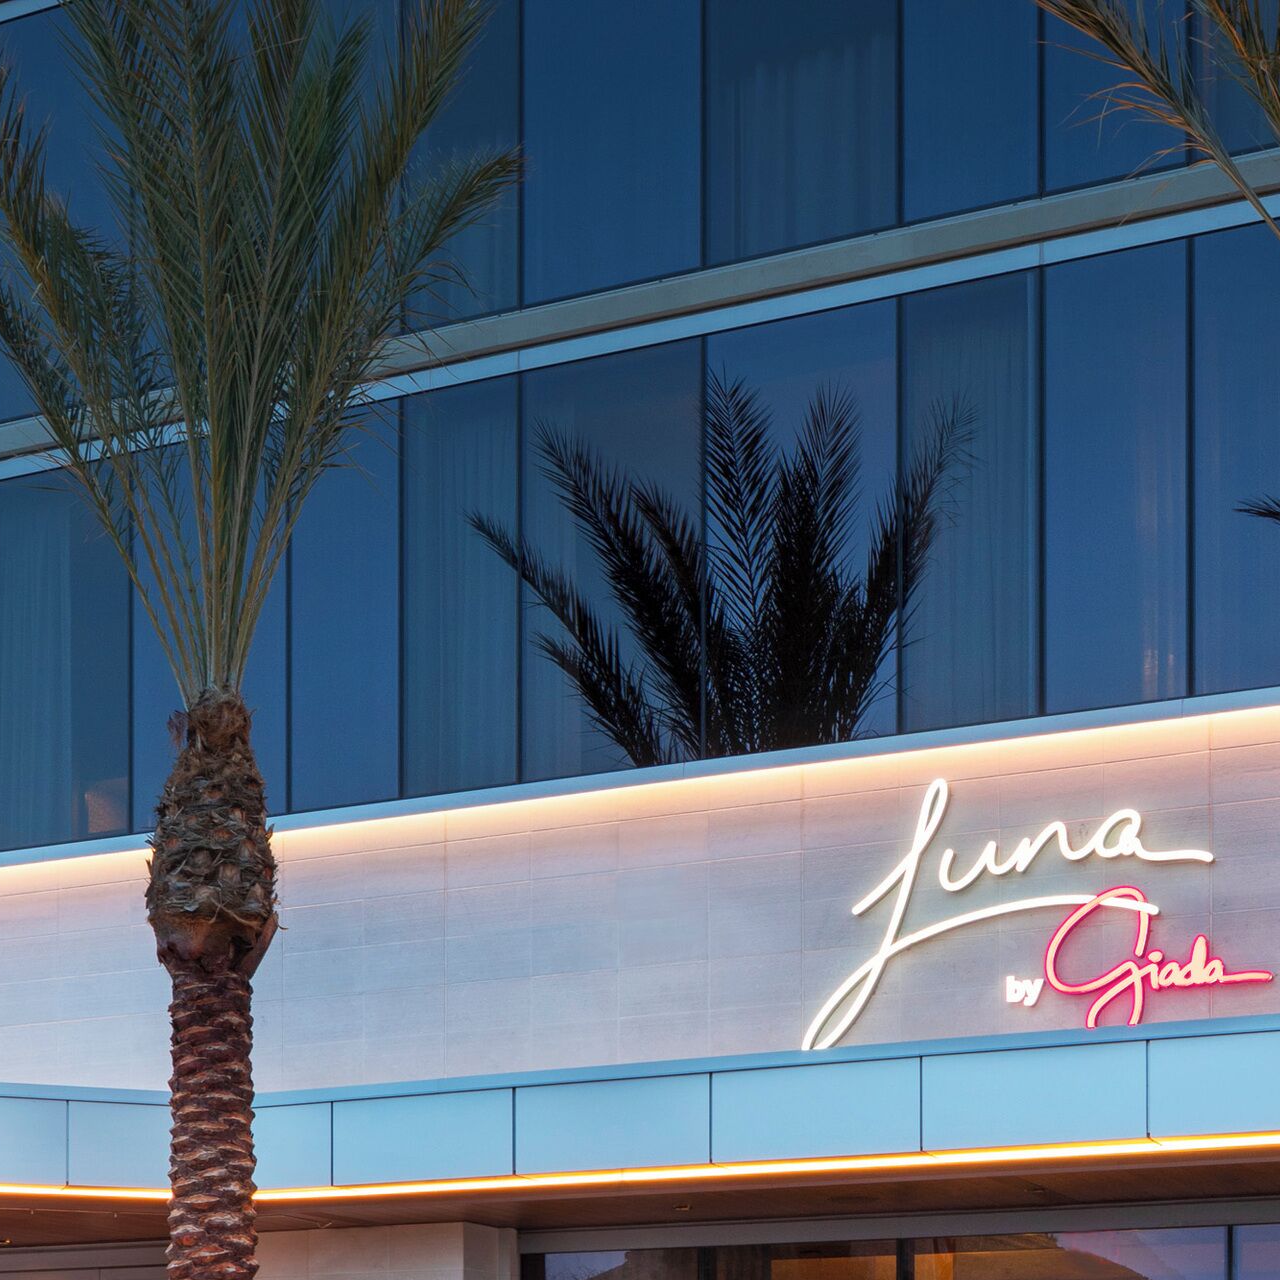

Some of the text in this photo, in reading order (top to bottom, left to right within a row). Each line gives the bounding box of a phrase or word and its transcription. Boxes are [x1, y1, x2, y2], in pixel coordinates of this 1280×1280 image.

[802, 778, 1214, 1050] Luna
[1005, 886, 1274, 1029] by Giada
